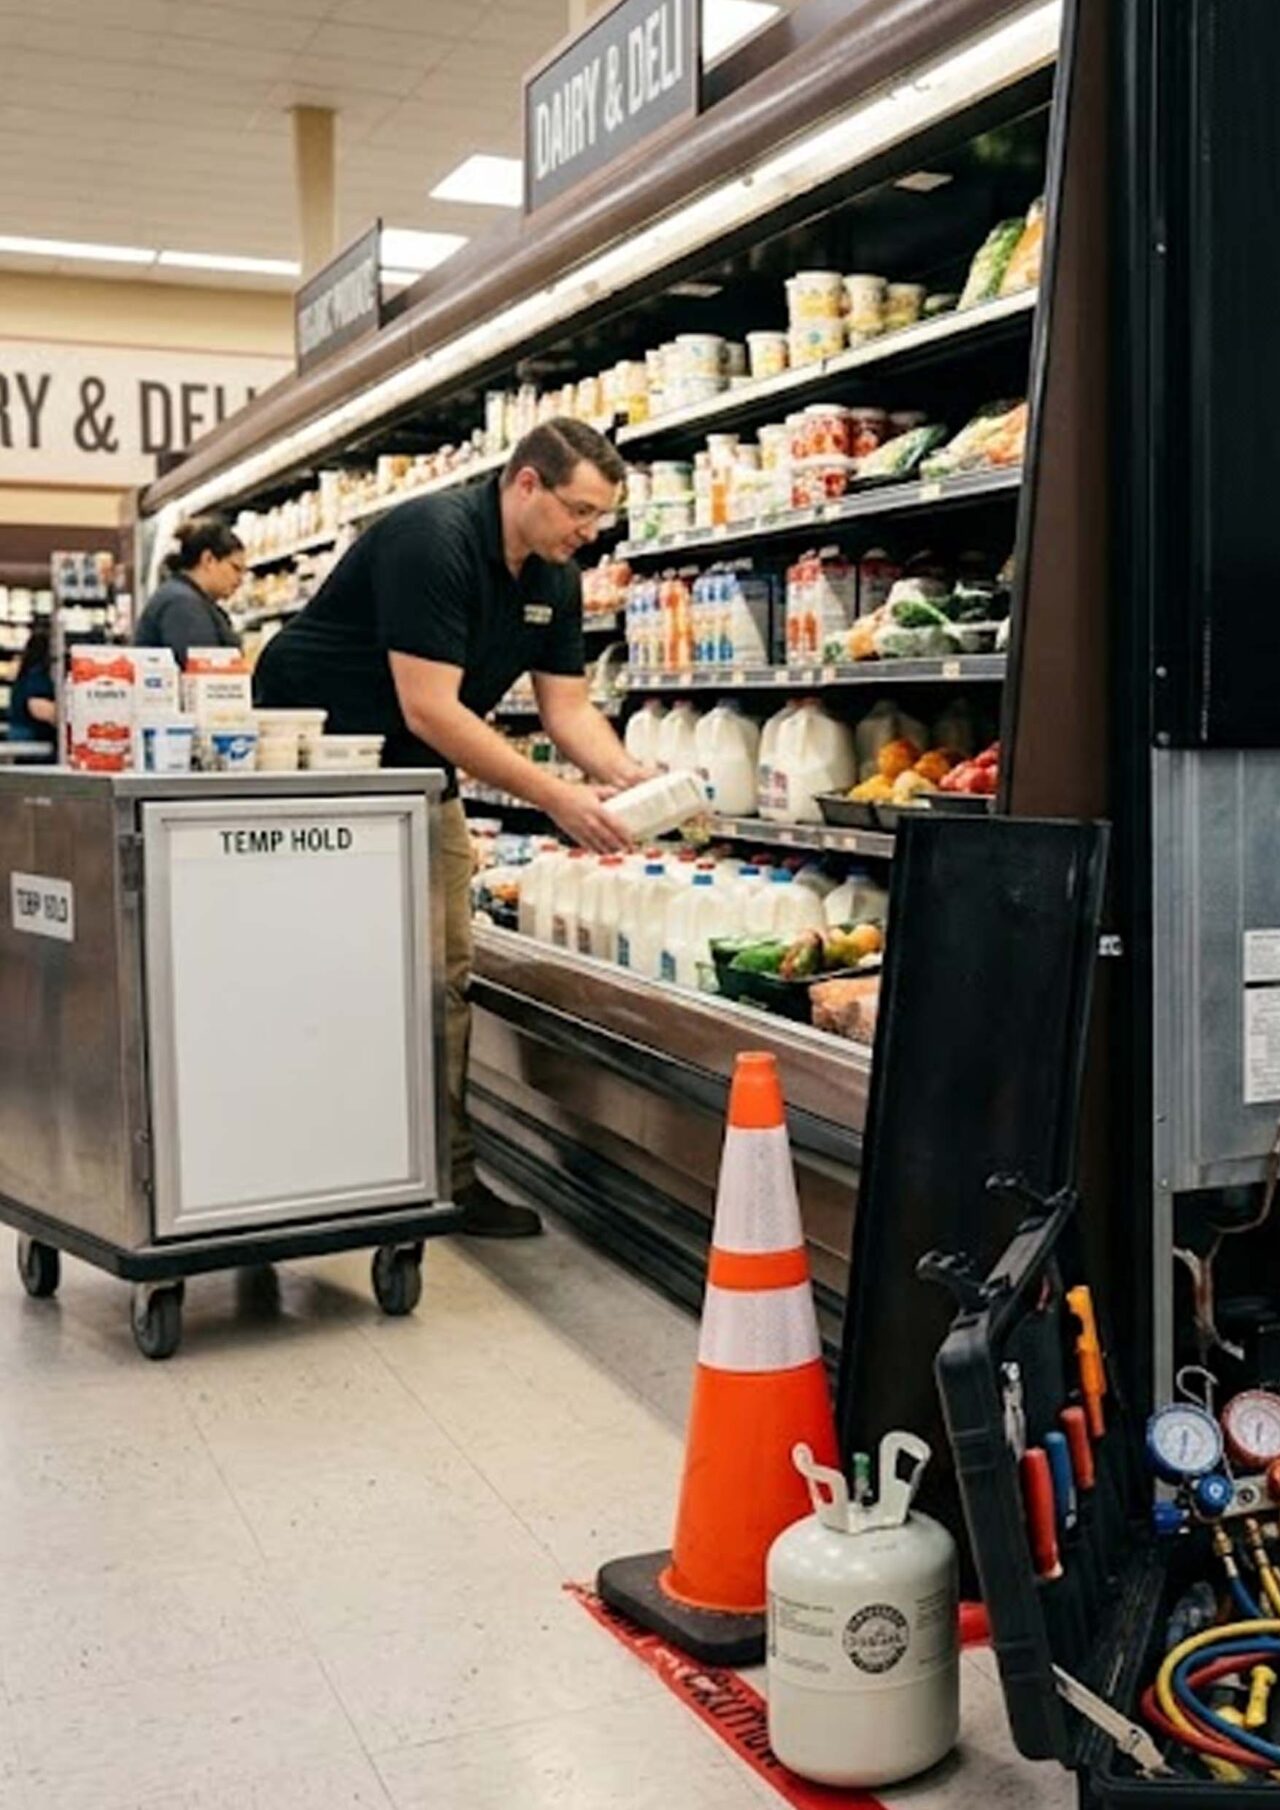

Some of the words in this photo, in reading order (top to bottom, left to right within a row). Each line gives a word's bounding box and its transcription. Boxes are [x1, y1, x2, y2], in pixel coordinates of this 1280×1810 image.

[536, 57, 600, 181] DAIRY
[603, 44, 624, 134] &
[628, 0, 684, 116] DELI
[73, 376, 119, 453] &
[139, 379, 256, 455] DE
[220, 829, 284, 855] TEMP
[291, 827, 353, 852] HOLD
